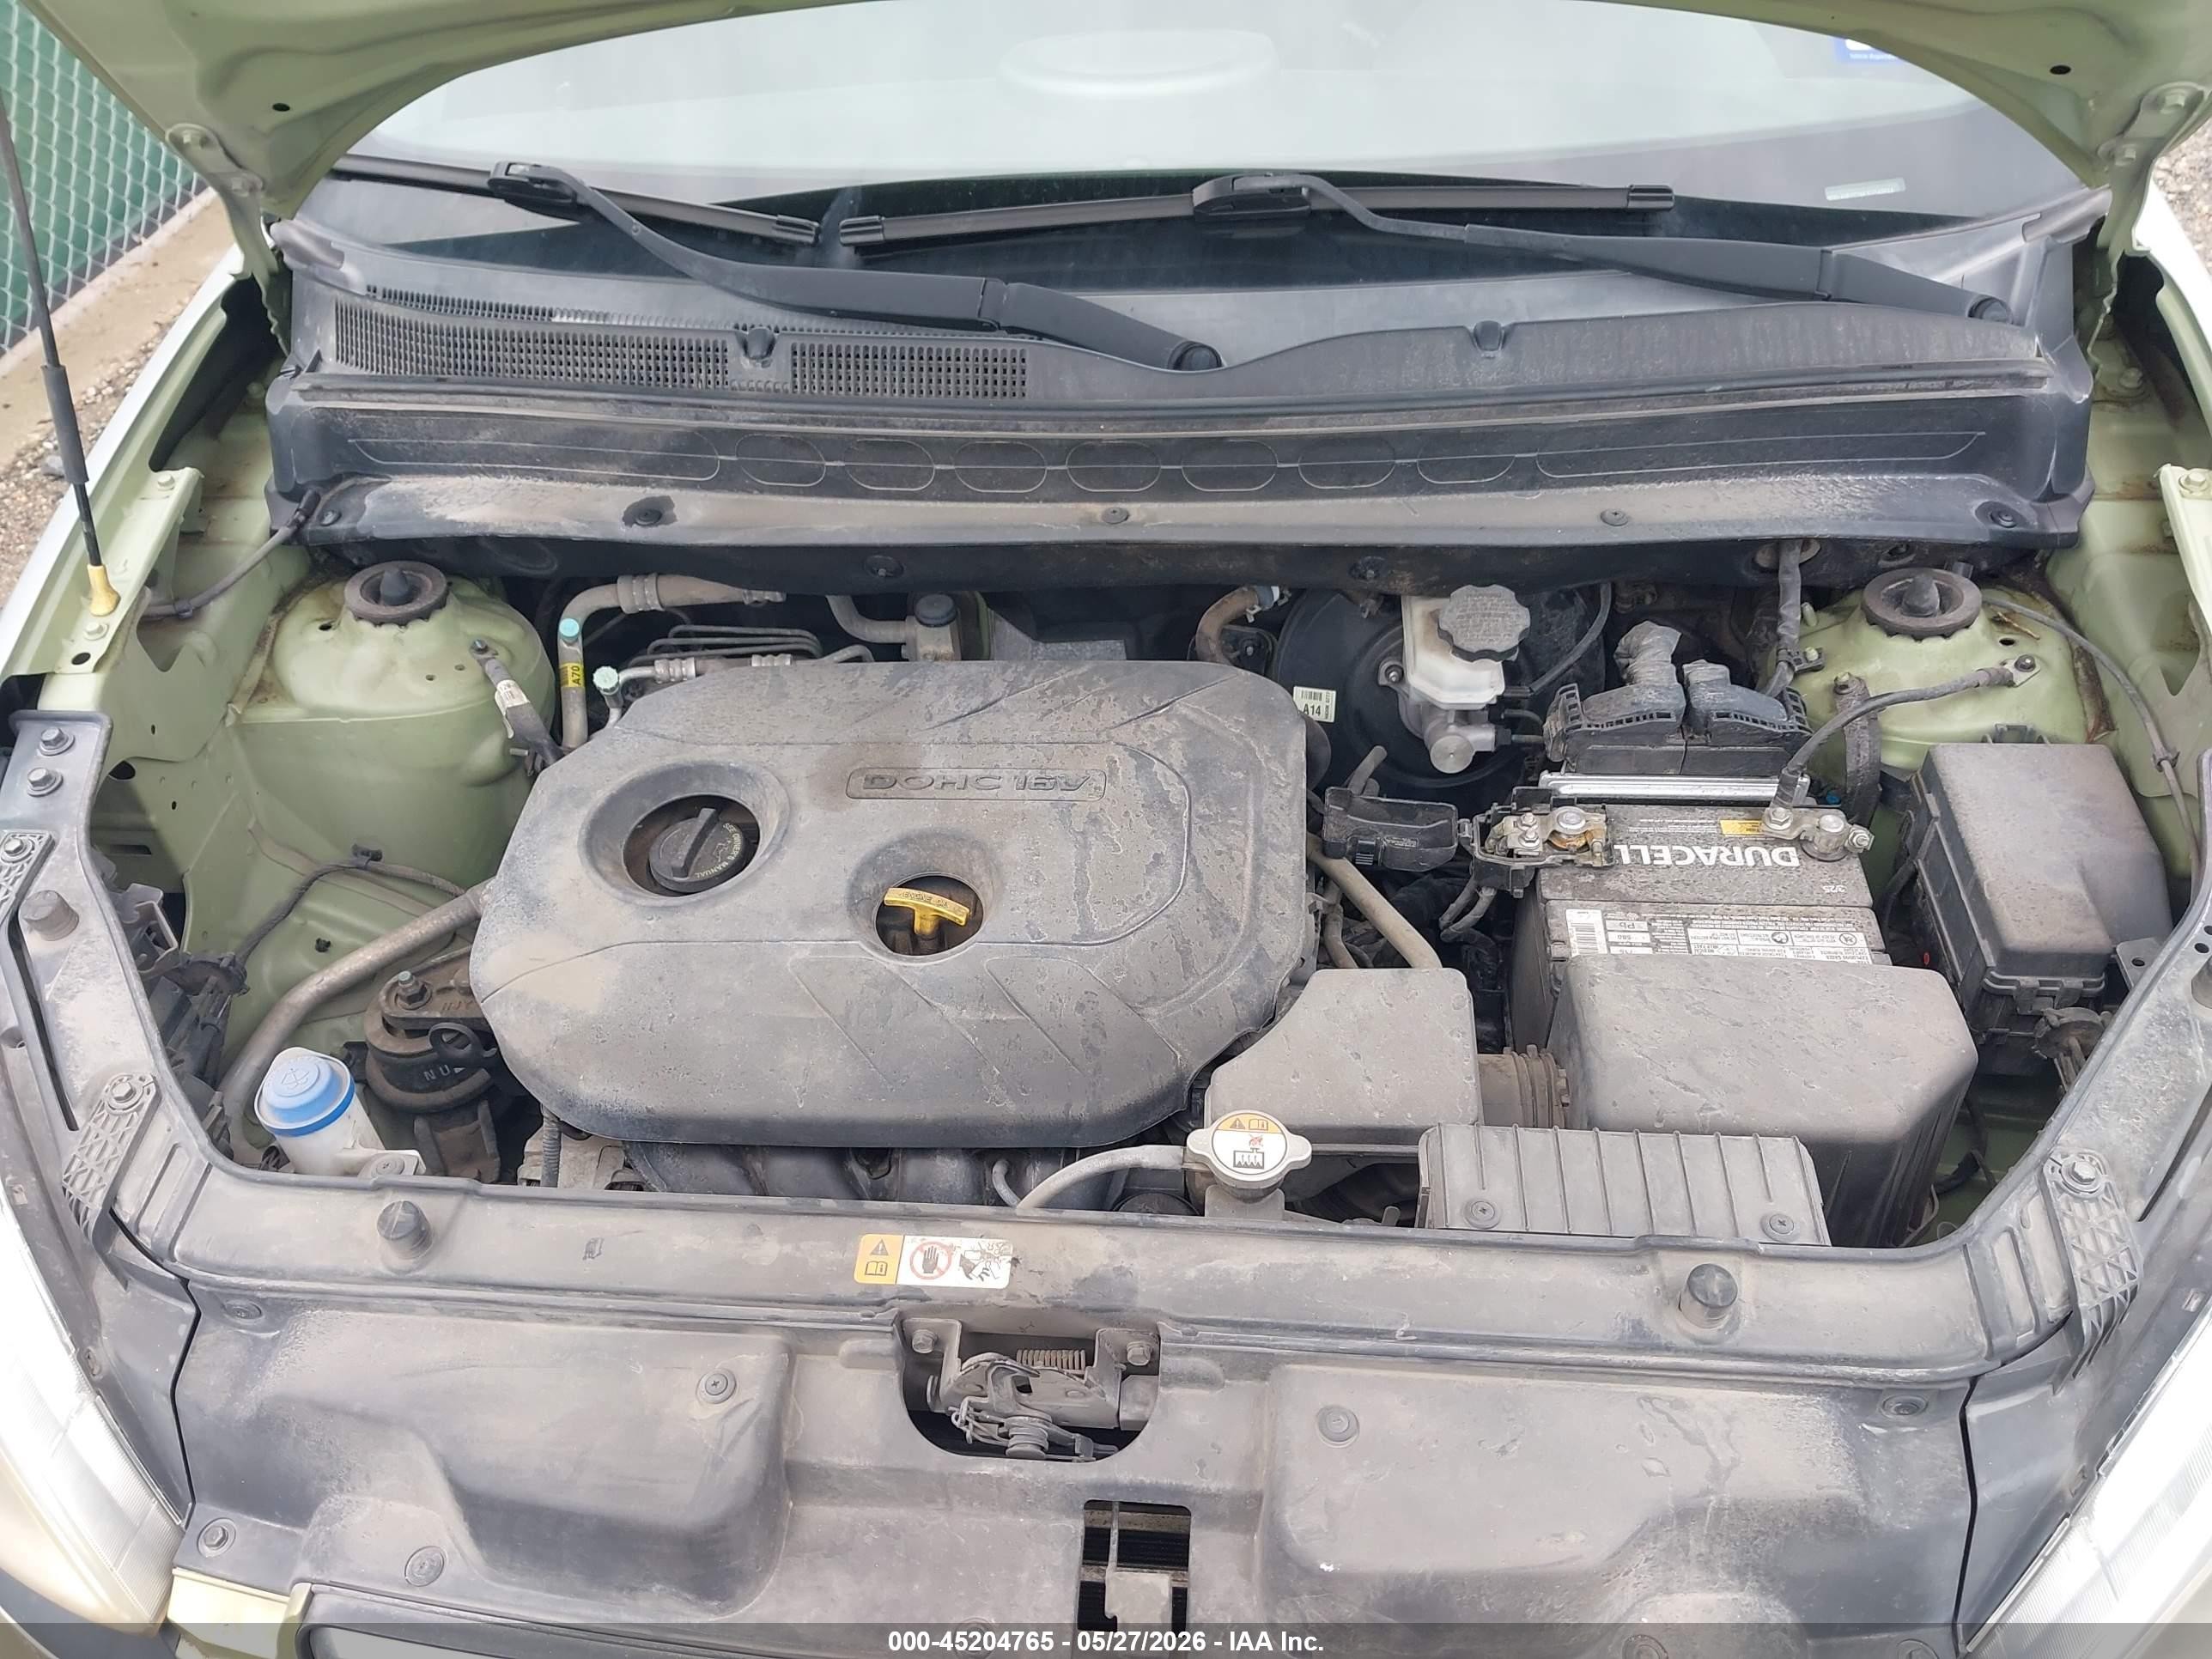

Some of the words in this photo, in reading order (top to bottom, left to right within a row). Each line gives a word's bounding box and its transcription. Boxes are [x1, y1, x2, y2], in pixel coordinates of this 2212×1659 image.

[570, 665, 581, 686] A70
[1303, 703, 1322, 716] A14
[862, 774, 1003, 792] DOHC
[1012, 774, 1091, 792] 16V
[1613, 844, 1801, 867] DURACELL
